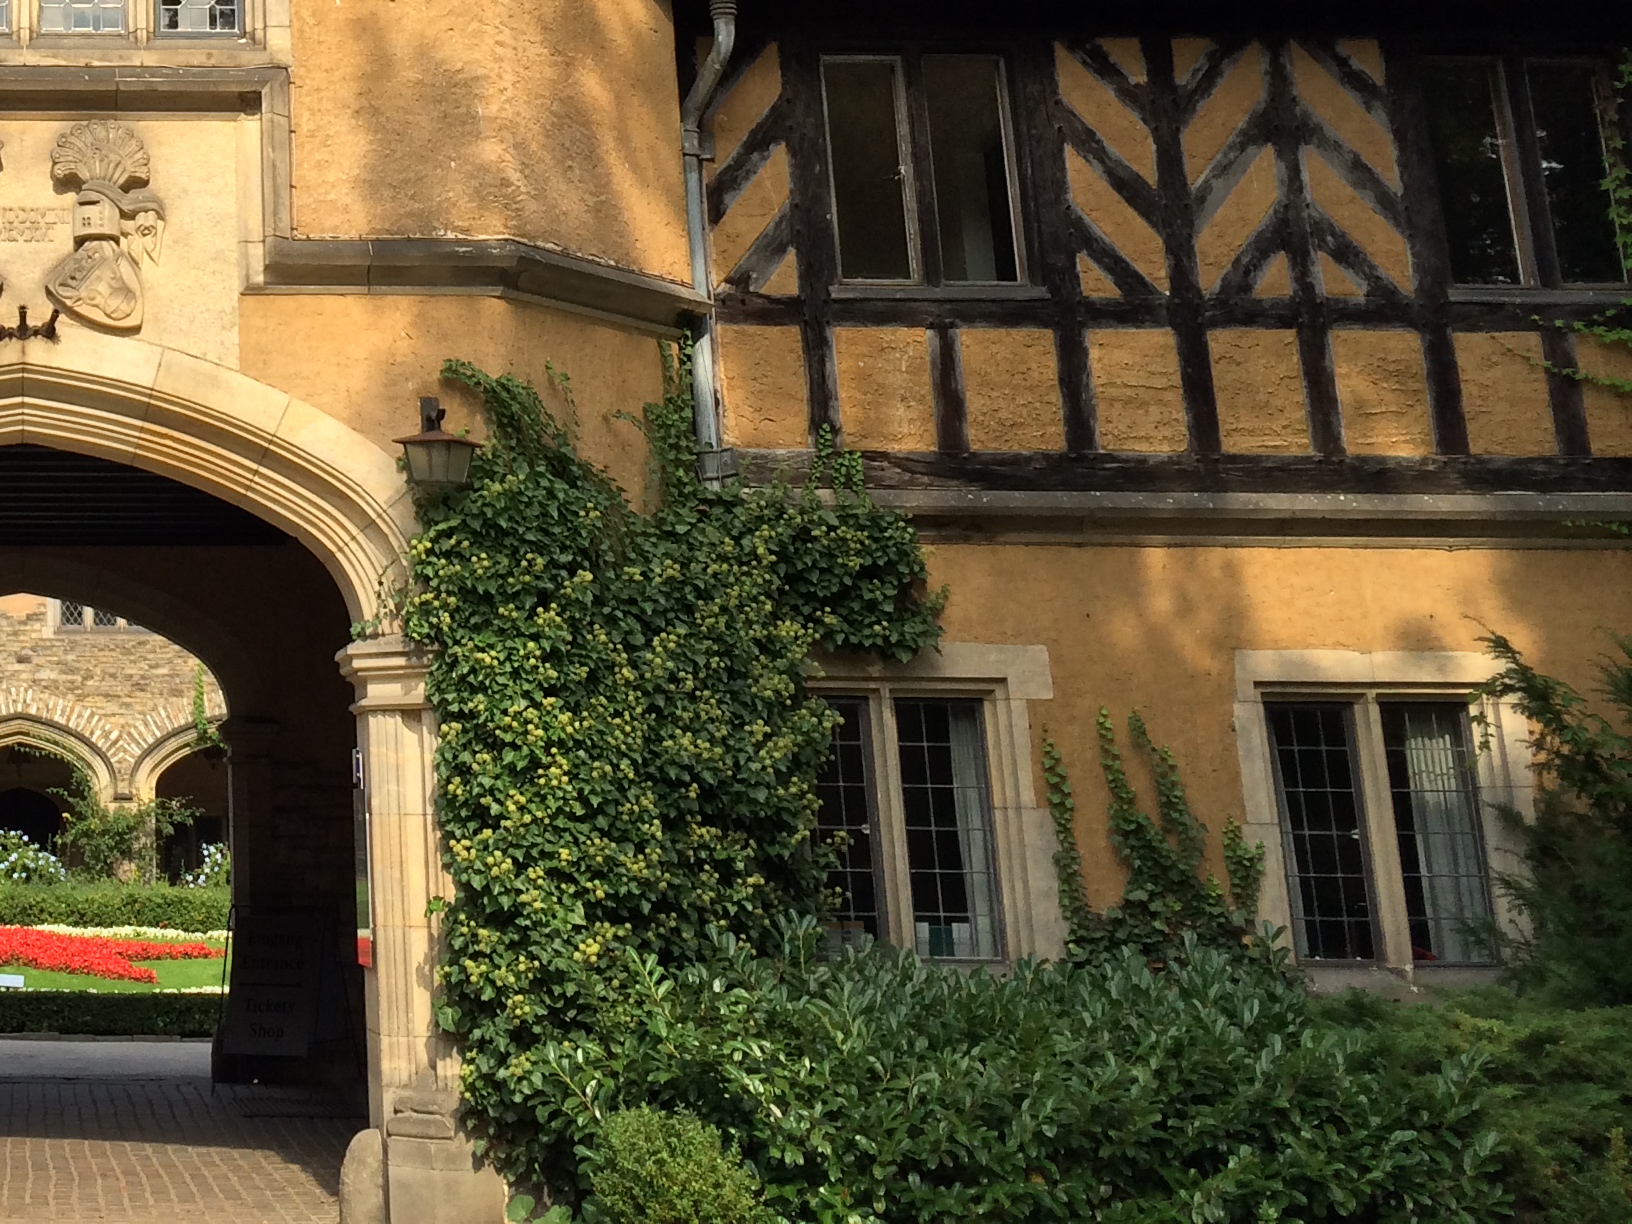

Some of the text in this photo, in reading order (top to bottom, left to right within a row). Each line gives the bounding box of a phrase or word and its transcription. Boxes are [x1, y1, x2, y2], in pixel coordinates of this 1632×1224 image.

[248, 931, 304, 949] Eingang
[242, 954, 305, 971] Entrance
[245, 998, 295, 1014] Tickets
[248, 1022, 286, 1041] Shop
